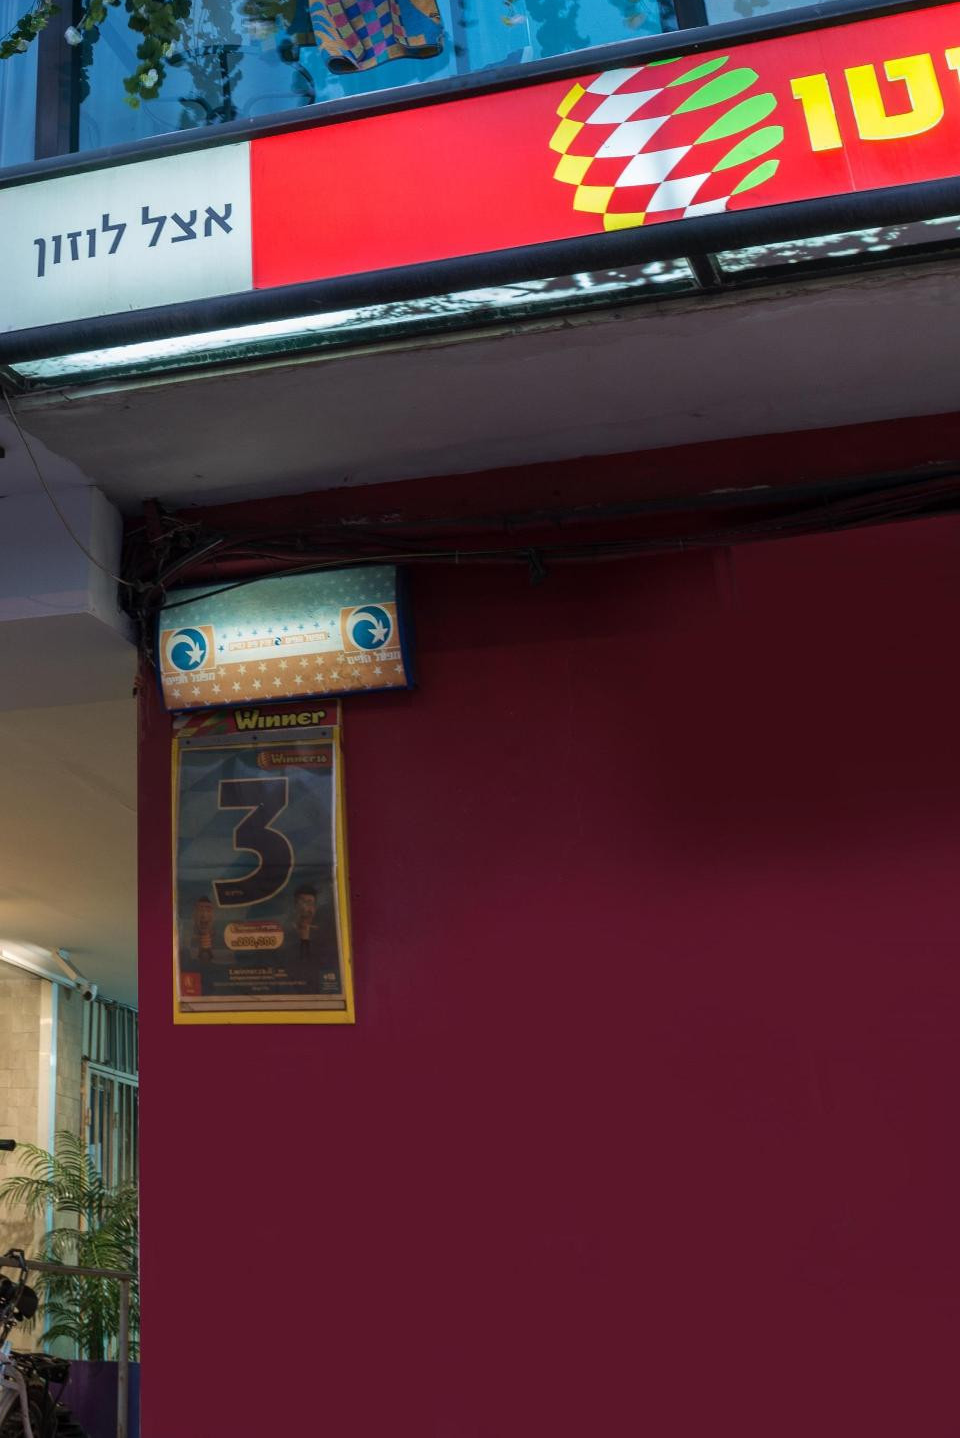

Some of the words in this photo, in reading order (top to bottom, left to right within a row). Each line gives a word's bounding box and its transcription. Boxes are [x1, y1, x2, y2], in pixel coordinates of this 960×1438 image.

[33, 213, 127, 277] לוזון
[141, 202, 233, 247] אצל
[234, 709, 326, 731] Winner
[212, 776, 295, 908] 3
